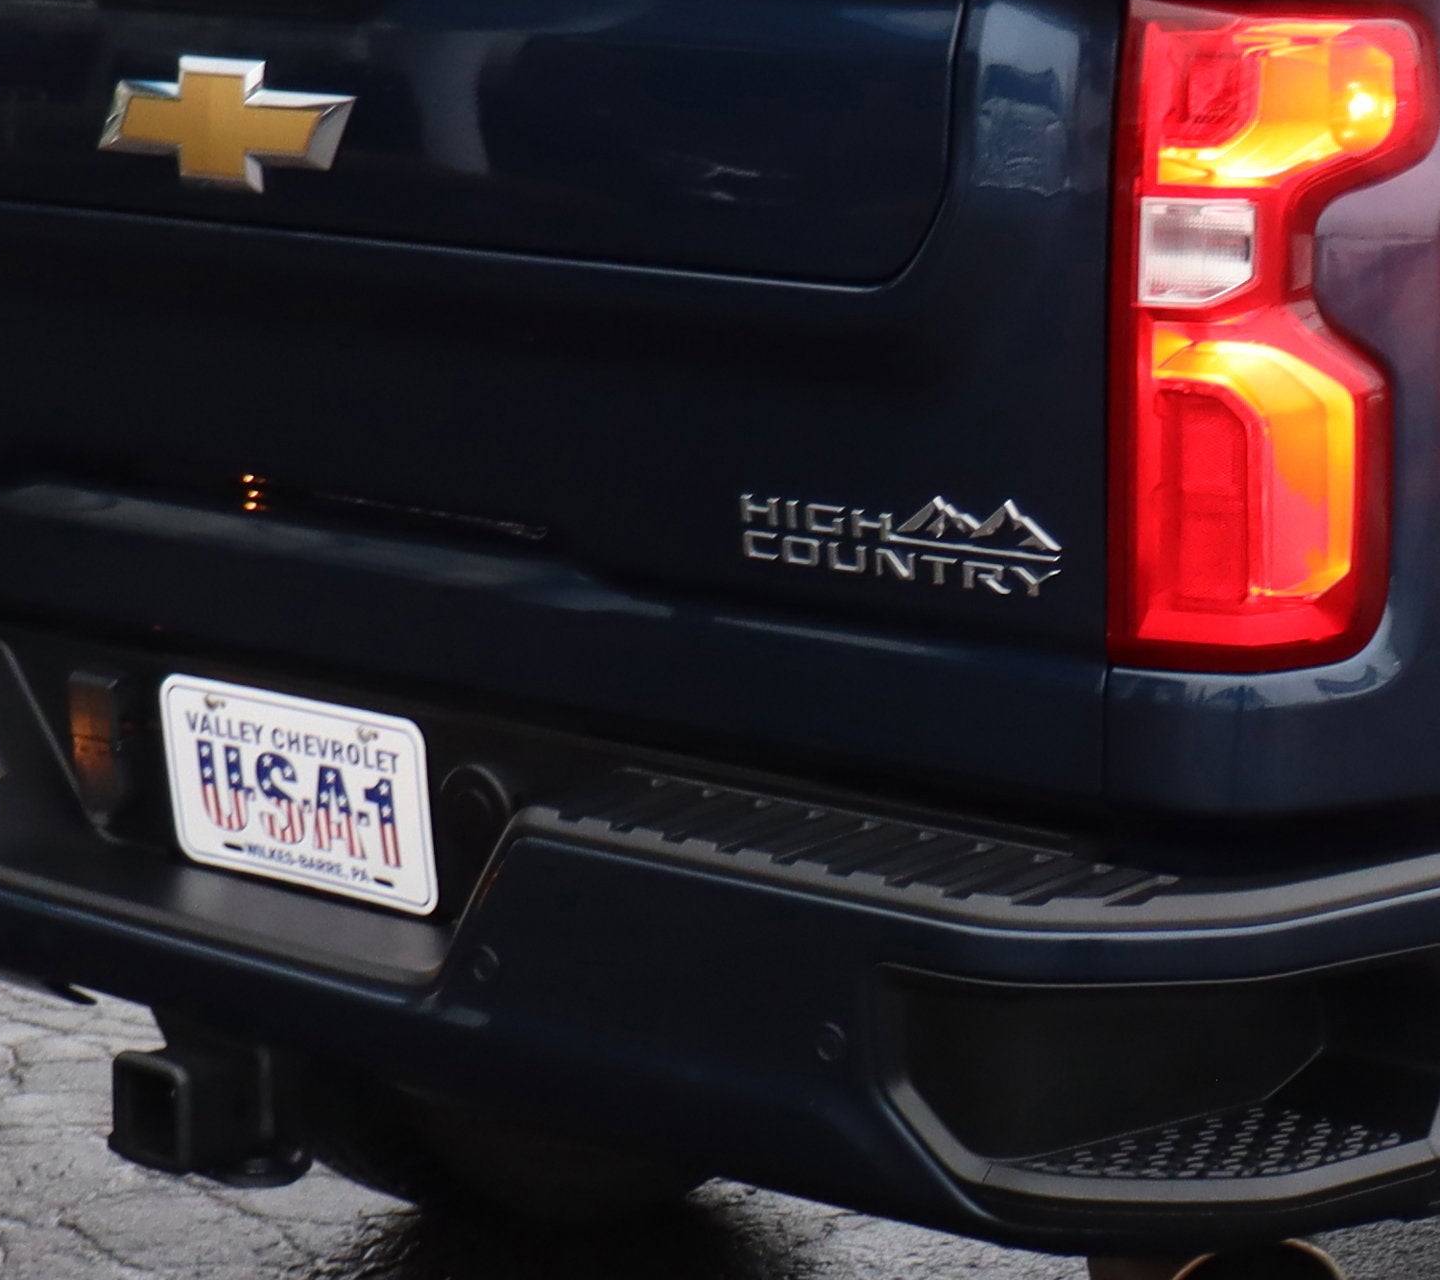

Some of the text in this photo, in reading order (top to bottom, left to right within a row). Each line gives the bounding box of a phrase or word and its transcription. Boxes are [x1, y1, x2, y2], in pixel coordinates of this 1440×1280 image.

[739, 493, 893, 543] HIGH
[741, 529, 1062, 597] COUNTRY
[184, 710, 400, 775] VALLEY CHEVROLET
